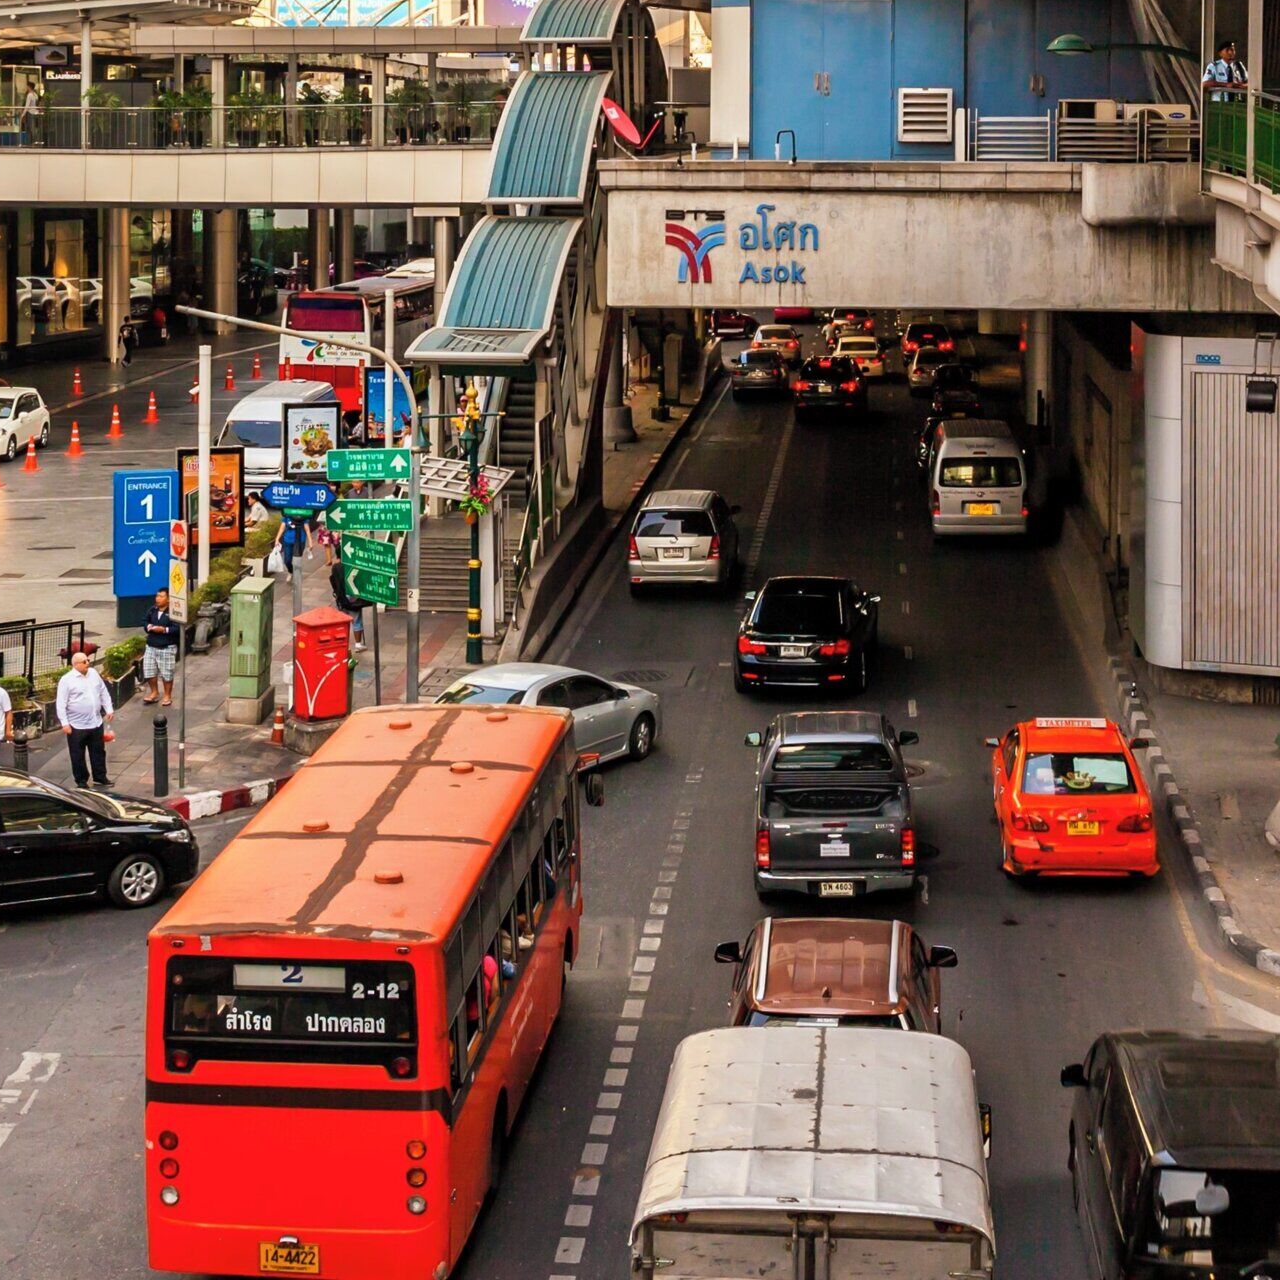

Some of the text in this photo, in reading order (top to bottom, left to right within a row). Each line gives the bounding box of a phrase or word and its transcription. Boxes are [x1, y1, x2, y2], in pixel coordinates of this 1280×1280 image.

[665, 209, 726, 221] BTS
[738, 203, 820, 251] อโศก
[738, 259, 807, 284] Asok
[127, 482, 168, 491] ENTRANCE
[315, 489, 327, 503] 19
[140, 494, 154, 520] 1
[408, 590, 414, 599] 2
[280, 965, 304, 984] 2
[351, 982, 400, 999] 2-12
[225, 1007, 386, 1034] สำโรง ปากคลอง
[265, 1248, 317, 1266] 14-4422
